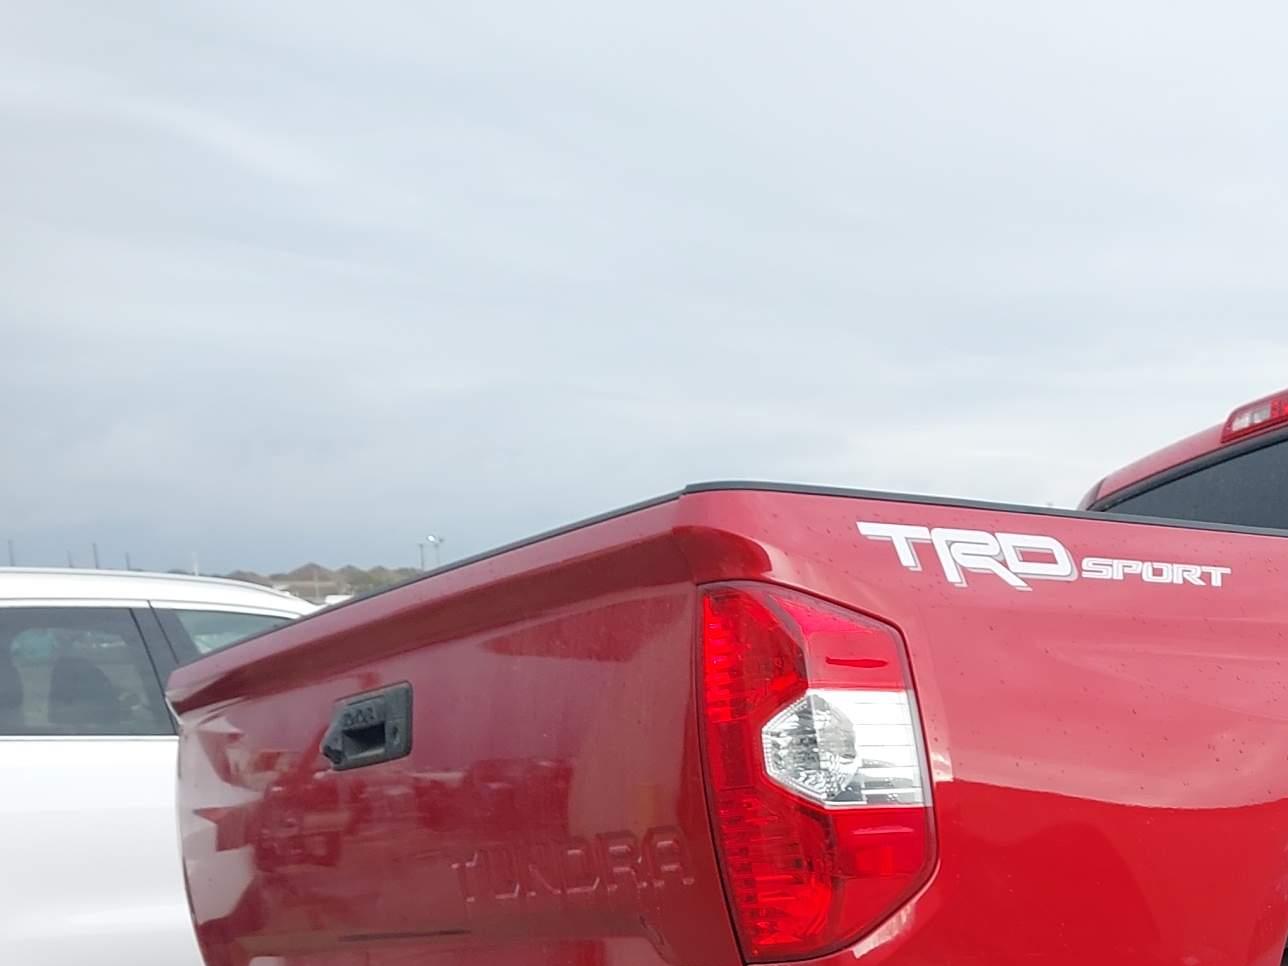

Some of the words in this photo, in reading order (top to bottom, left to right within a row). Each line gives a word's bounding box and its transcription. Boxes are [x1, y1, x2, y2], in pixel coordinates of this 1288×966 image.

[856, 521, 1079, 592] TRD
[1081, 557, 1232, 588] SPORT
[450, 827, 695, 903] TUNDRA
